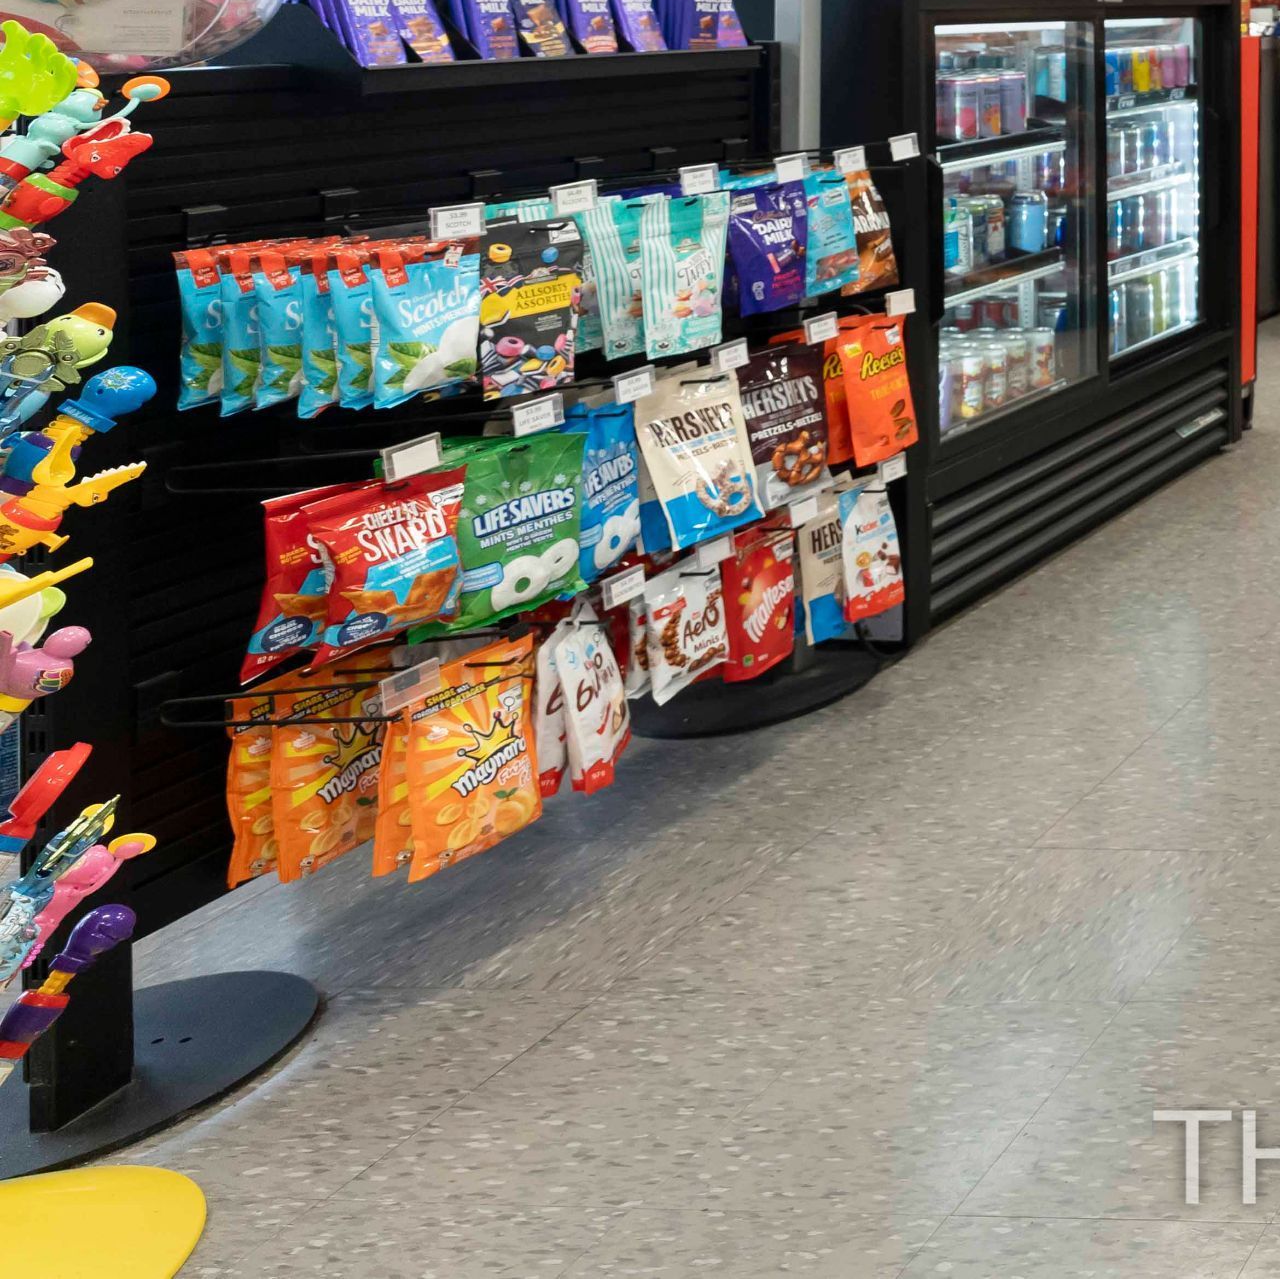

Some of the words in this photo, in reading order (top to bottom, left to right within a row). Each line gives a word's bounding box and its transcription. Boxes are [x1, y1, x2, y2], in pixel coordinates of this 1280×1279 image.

[355, 3, 390, 18] MILK
[764, 230, 794, 246] MILK
[398, 276, 469, 328] Scotch
[515, 282, 568, 301] ALLSORTS
[473, 510, 509, 538] LIFE
[507, 487, 576, 529] SAVERS
[480, 528, 516, 550] MINTS
[517, 510, 573, 536] MENTHES
[426, 686, 457, 708] SHARE
